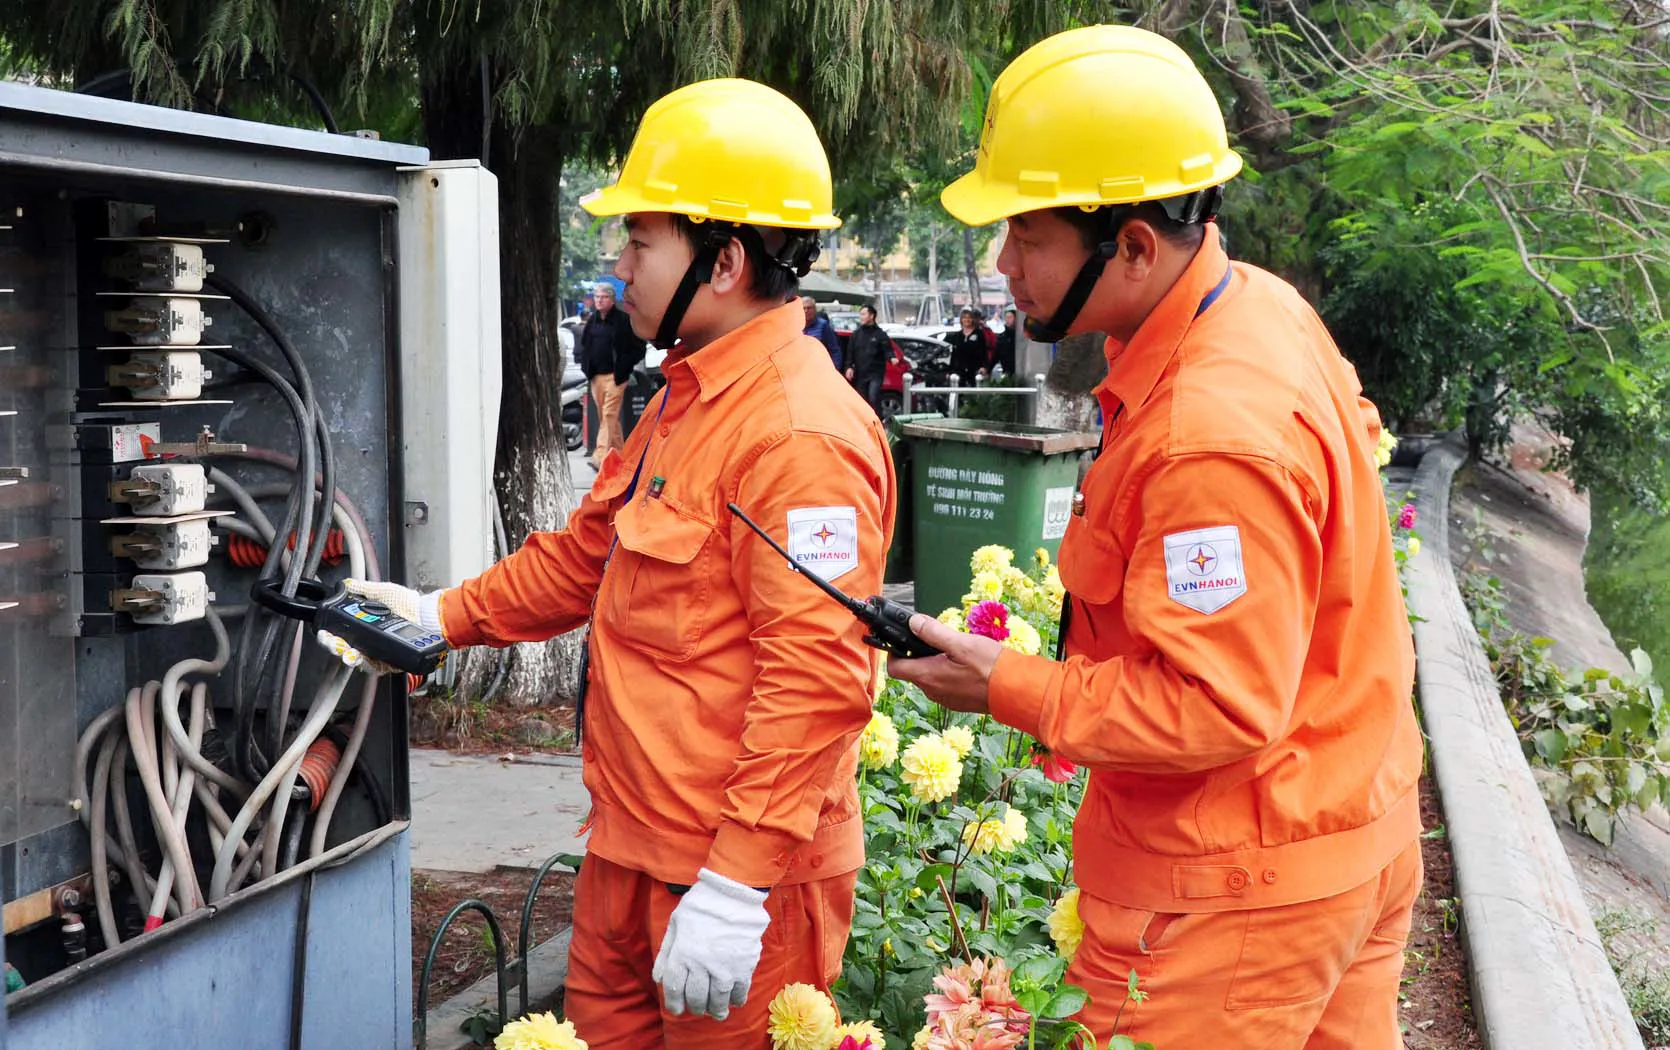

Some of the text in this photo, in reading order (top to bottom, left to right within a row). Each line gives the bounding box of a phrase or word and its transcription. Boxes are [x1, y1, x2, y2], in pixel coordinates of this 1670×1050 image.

[969, 508, 981, 519] 23
[796, 552, 850, 561] EVNHANOI
[1175, 577, 1237, 592] EVNHANOI
